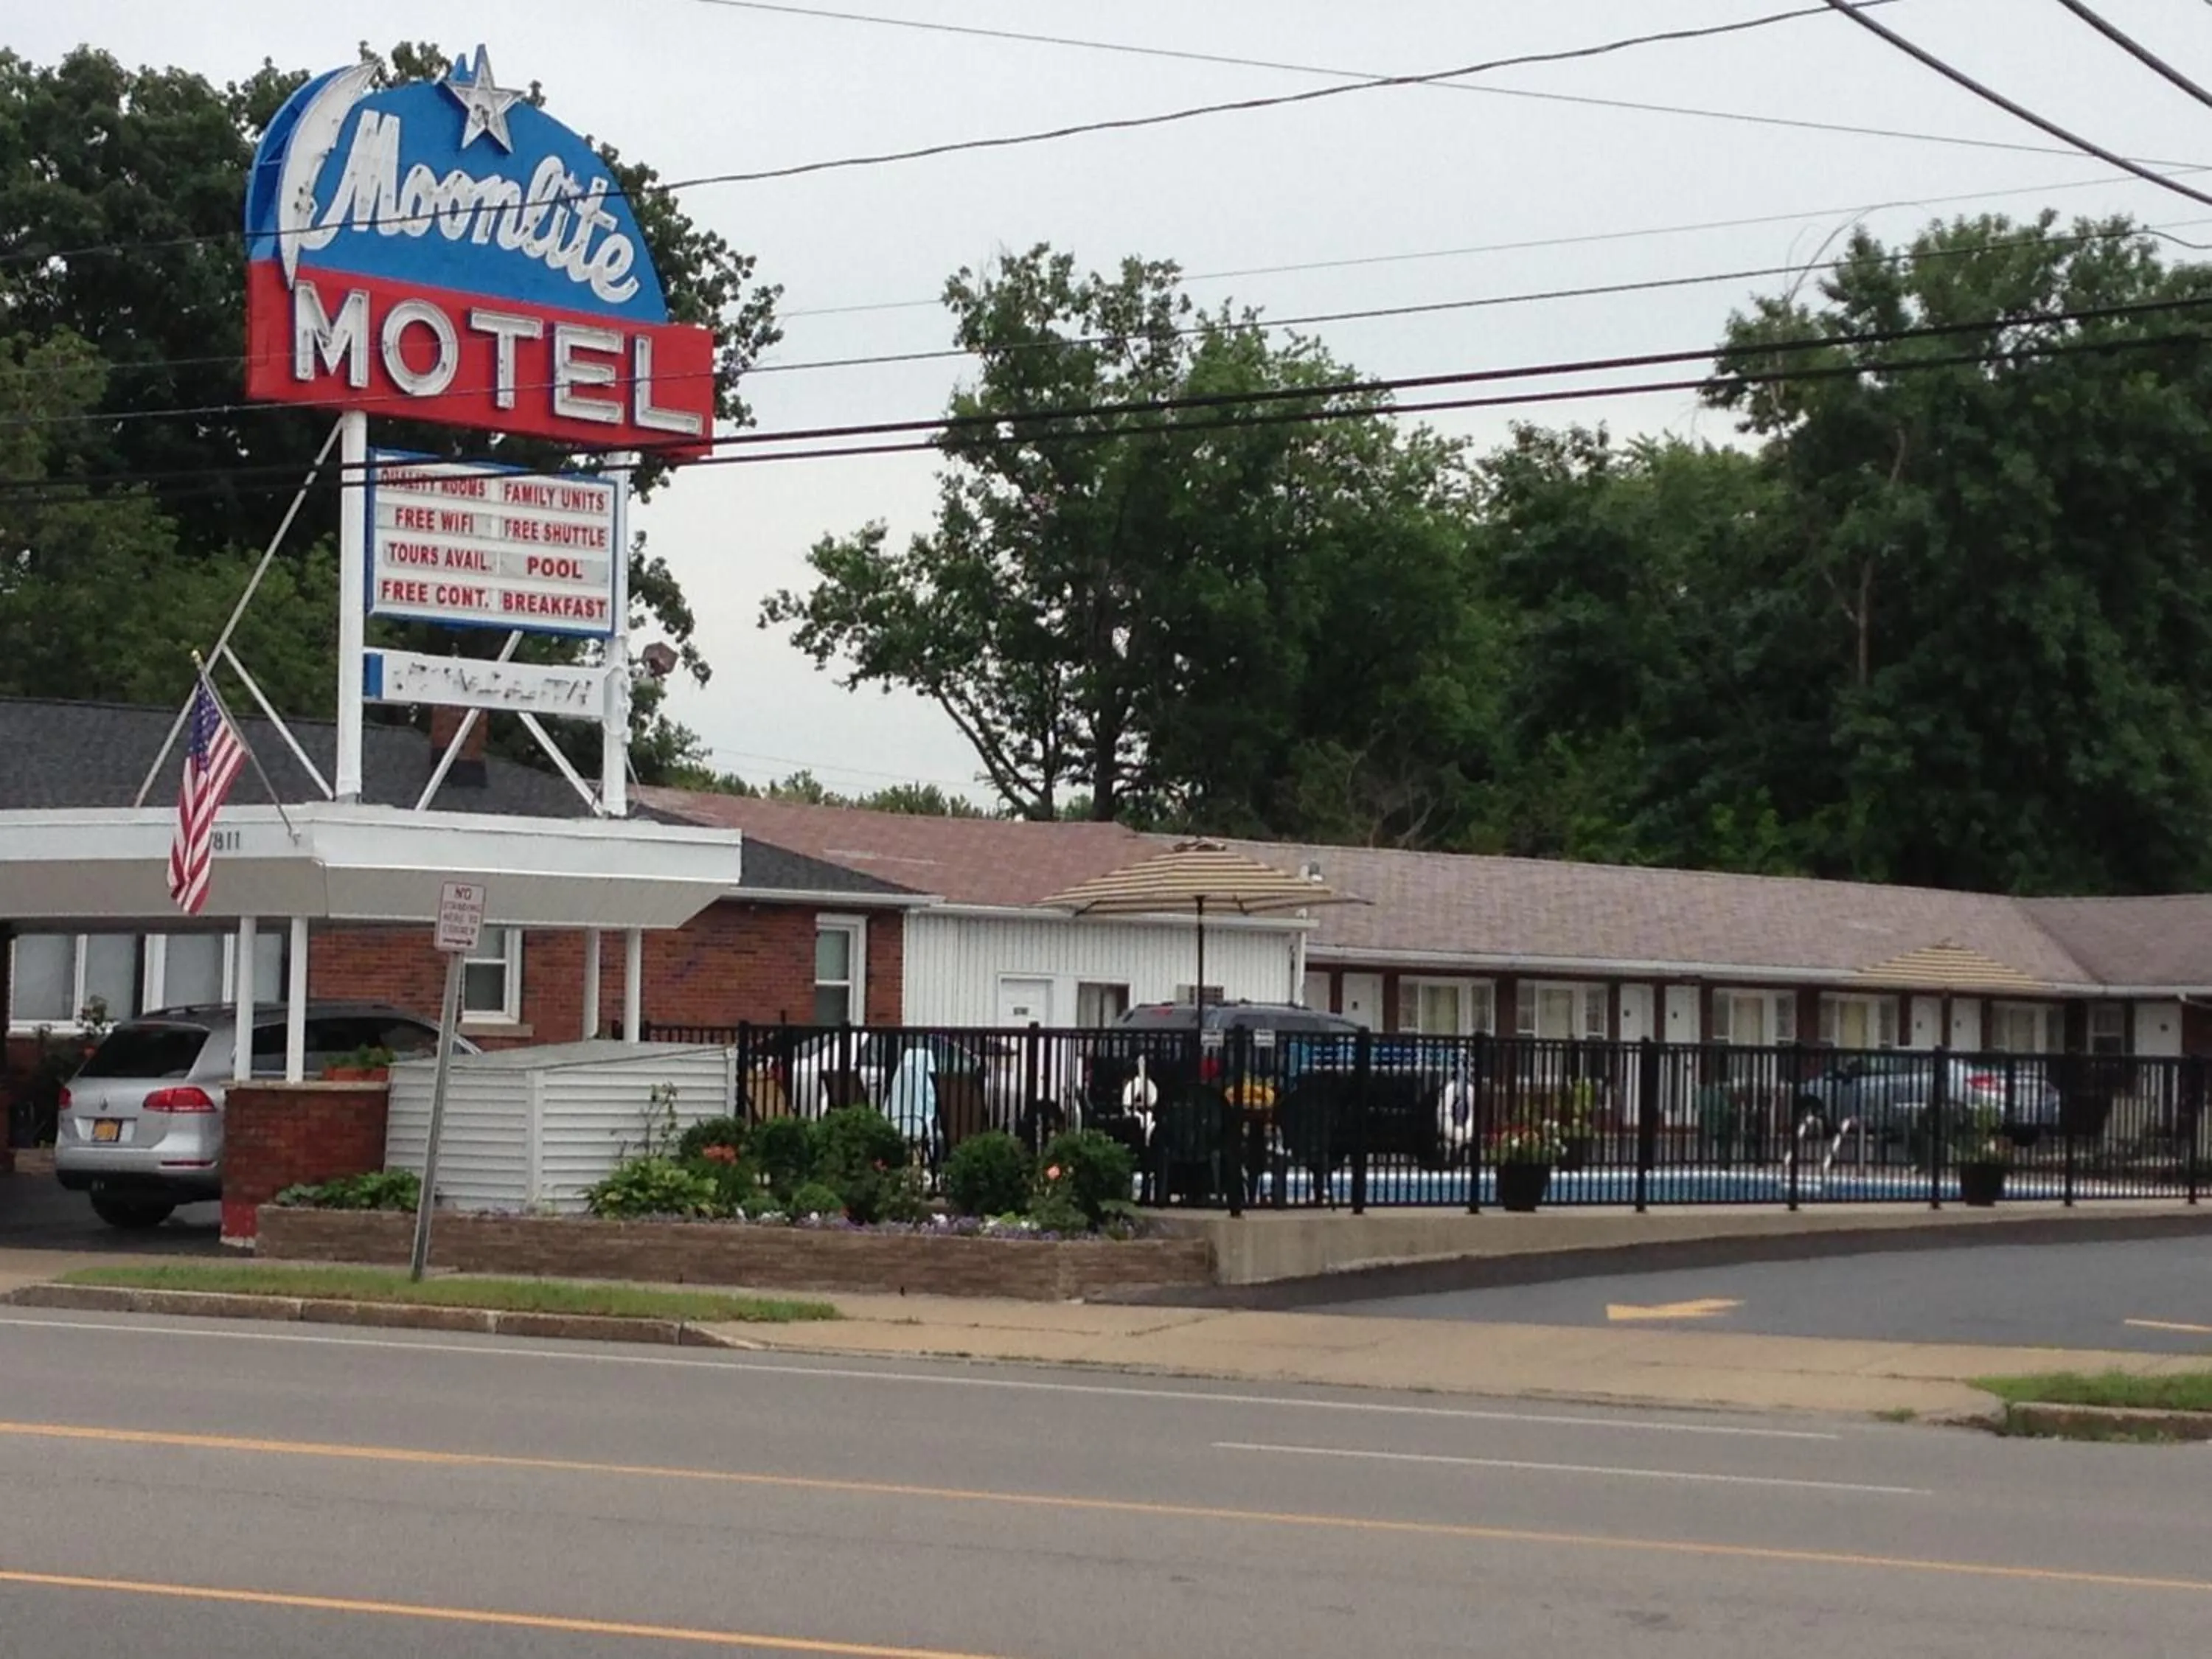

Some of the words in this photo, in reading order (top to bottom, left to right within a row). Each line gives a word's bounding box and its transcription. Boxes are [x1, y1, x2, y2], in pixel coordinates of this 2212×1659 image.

[298, 108, 640, 304] Moonlite
[294, 279, 703, 437] MOTEL
[442, 476, 486, 498] ROOMS
[504, 482, 554, 508] FAMILY
[561, 488, 605, 512] UNITS
[394, 507, 435, 530] FREE
[441, 510, 474, 534] WIFI
[504, 518, 538, 541] FREE
[543, 522, 606, 548] SHUTTLE
[389, 542, 439, 566] TOURS
[445, 548, 493, 572] AVAIL.
[526, 555, 583, 580] POOL
[380, 580, 428, 603] FREE
[436, 584, 490, 609] CONT.
[502, 591, 607, 619] BREAKFAST
[455, 886, 472, 900] NO
